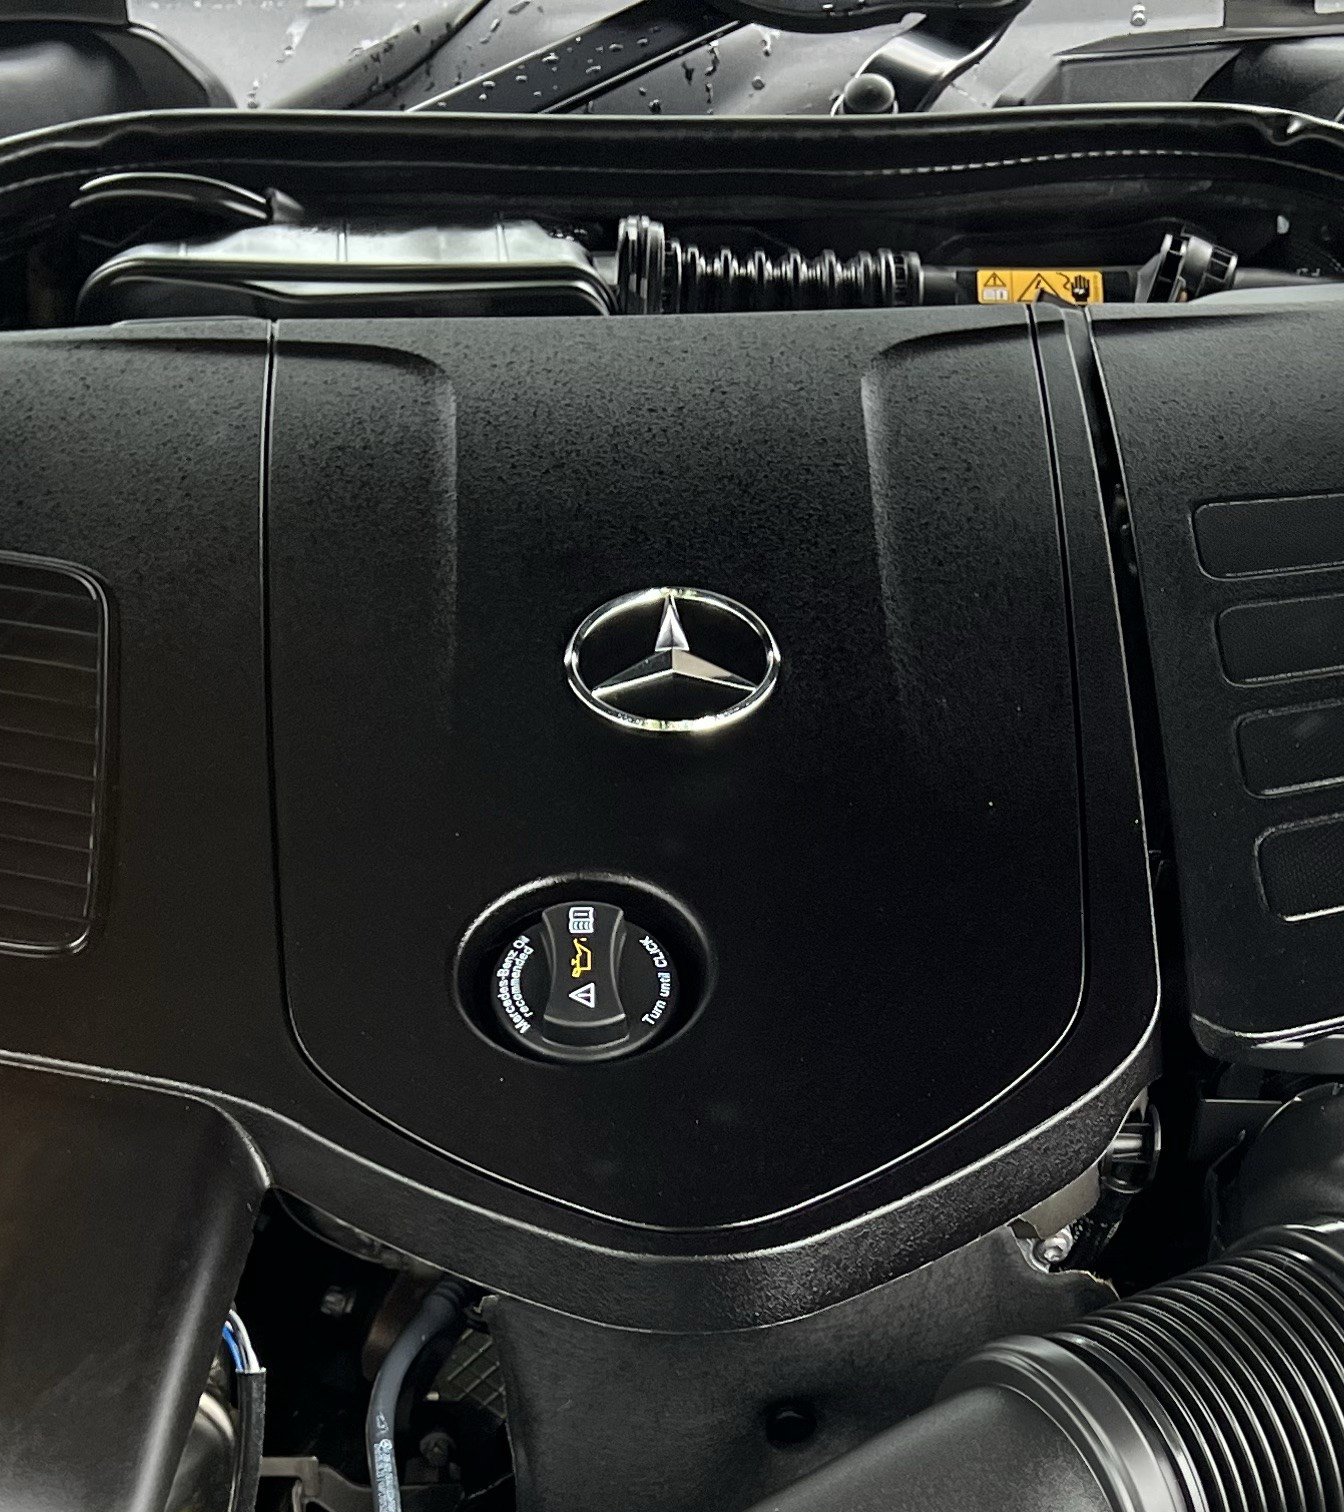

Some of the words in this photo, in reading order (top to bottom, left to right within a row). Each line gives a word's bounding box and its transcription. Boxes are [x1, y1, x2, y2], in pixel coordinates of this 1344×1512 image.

[639, 935, 668, 968] CLICK
[497, 949, 531, 1034] Mercedes-Benz
[511, 945, 534, 1017] recommended
[657, 972, 671, 997] until
[641, 1000, 667, 1025] Turn
